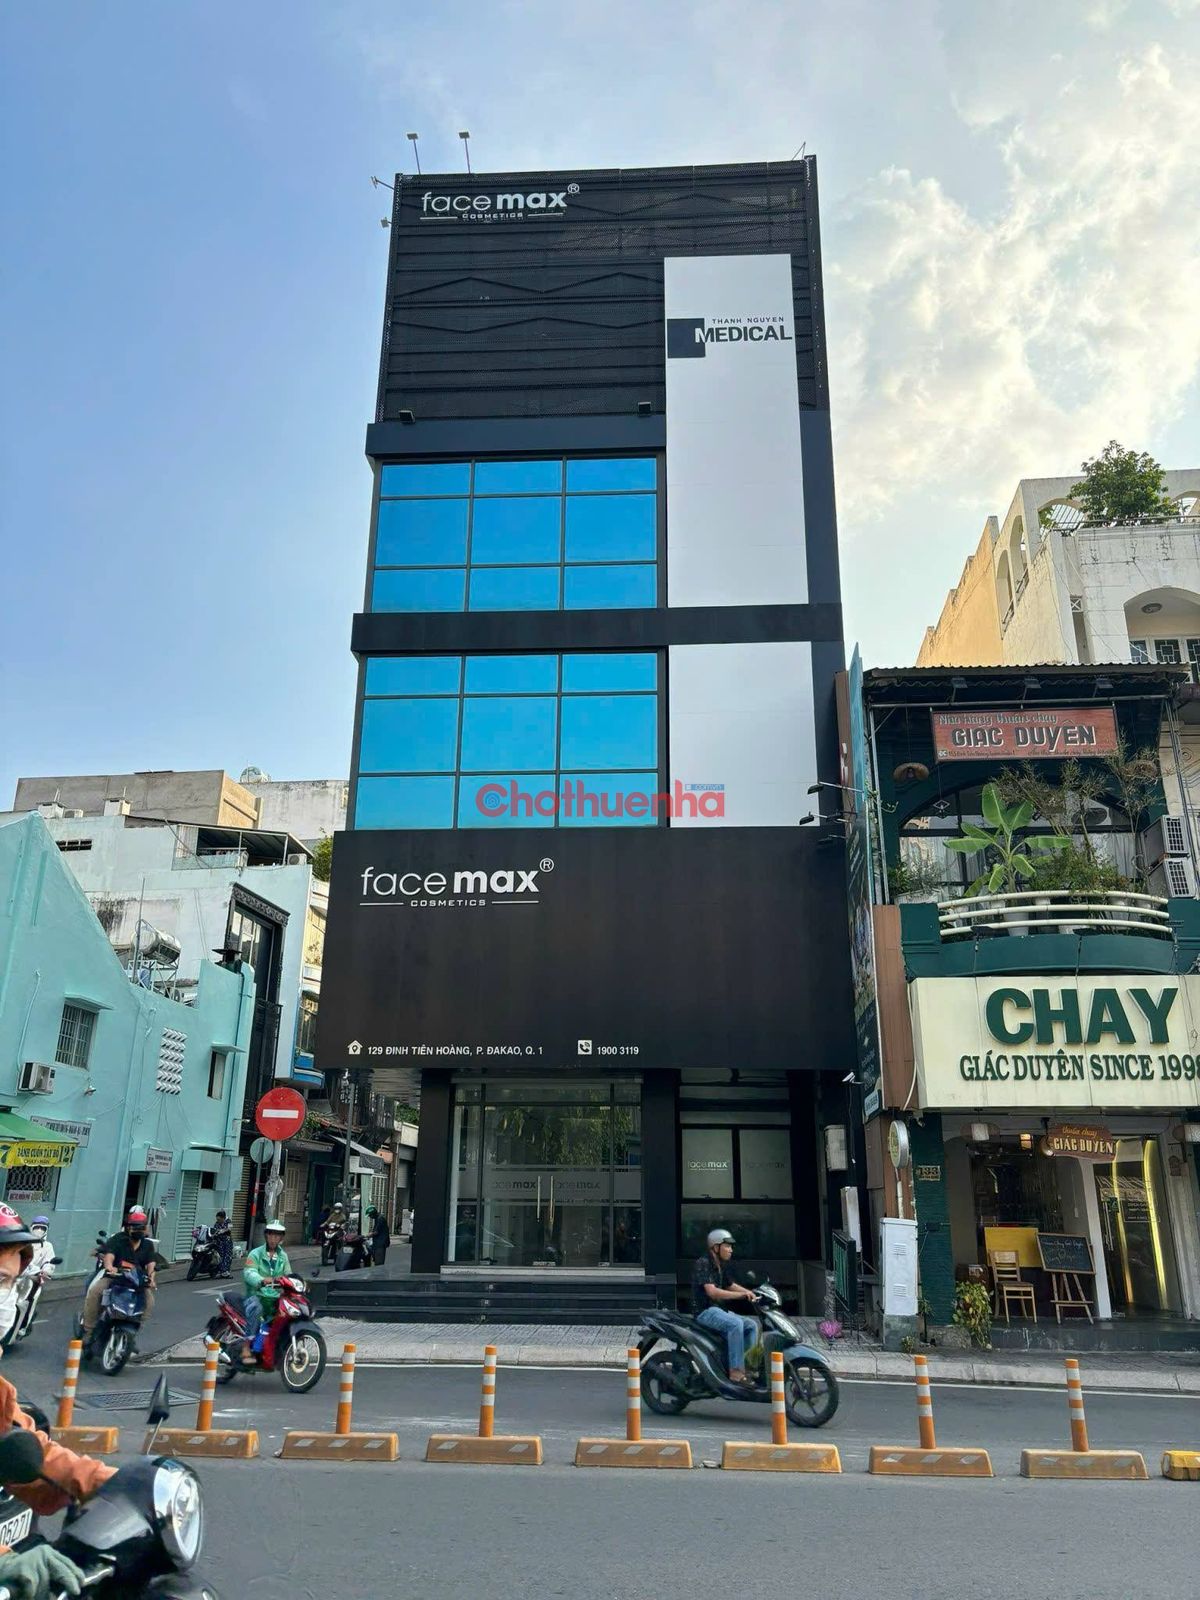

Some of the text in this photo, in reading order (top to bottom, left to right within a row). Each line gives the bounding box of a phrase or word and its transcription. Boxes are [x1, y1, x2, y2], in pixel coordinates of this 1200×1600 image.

[421, 191, 491, 212] face
[747, 316, 784, 324] NGUYEN
[694, 325, 793, 343] MEDICAL
[360, 866, 447, 895] face
[411, 899, 486, 907] COSMETICS
[985, 987, 1179, 1045] CHAY
[367, 1046, 383, 1055] 129
[411, 1044, 433, 1055] TIÊN
[476, 1046, 484, 1055] P.
[486, 1046, 523, 1056] ĐAKAO,
[525, 1046, 535, 1056] Q.
[538, 1046, 543, 1055] 1
[597, 1046, 639, 1055] 1900 3119
[960, 1050, 1010, 1081] GIÁC
[1013, 1048, 1086, 1081] DUYÊN
[1090, 1054, 1155, 1081] SINCE
[1053, 1135, 1078, 1151] GIÁC
